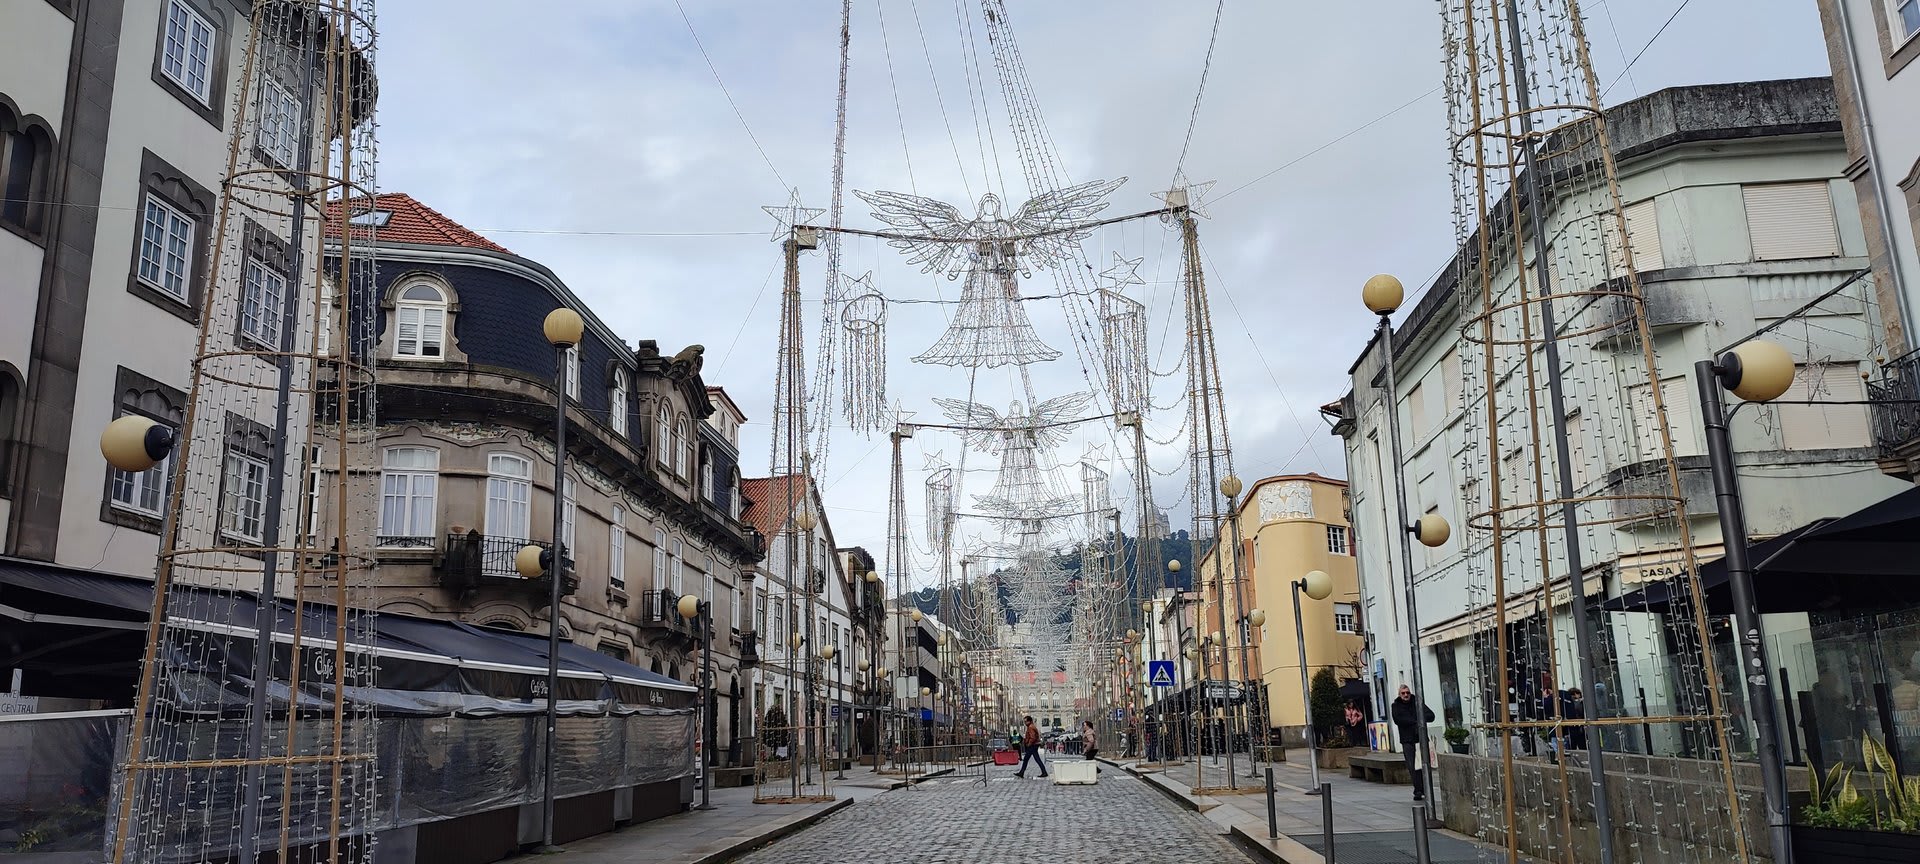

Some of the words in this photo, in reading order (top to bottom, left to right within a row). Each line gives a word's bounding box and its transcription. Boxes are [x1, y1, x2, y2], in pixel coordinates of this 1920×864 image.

[1641, 567, 1673, 578] CASA
[314, 655, 334, 679] Café
[1, 703, 35, 714] CENTRAL
